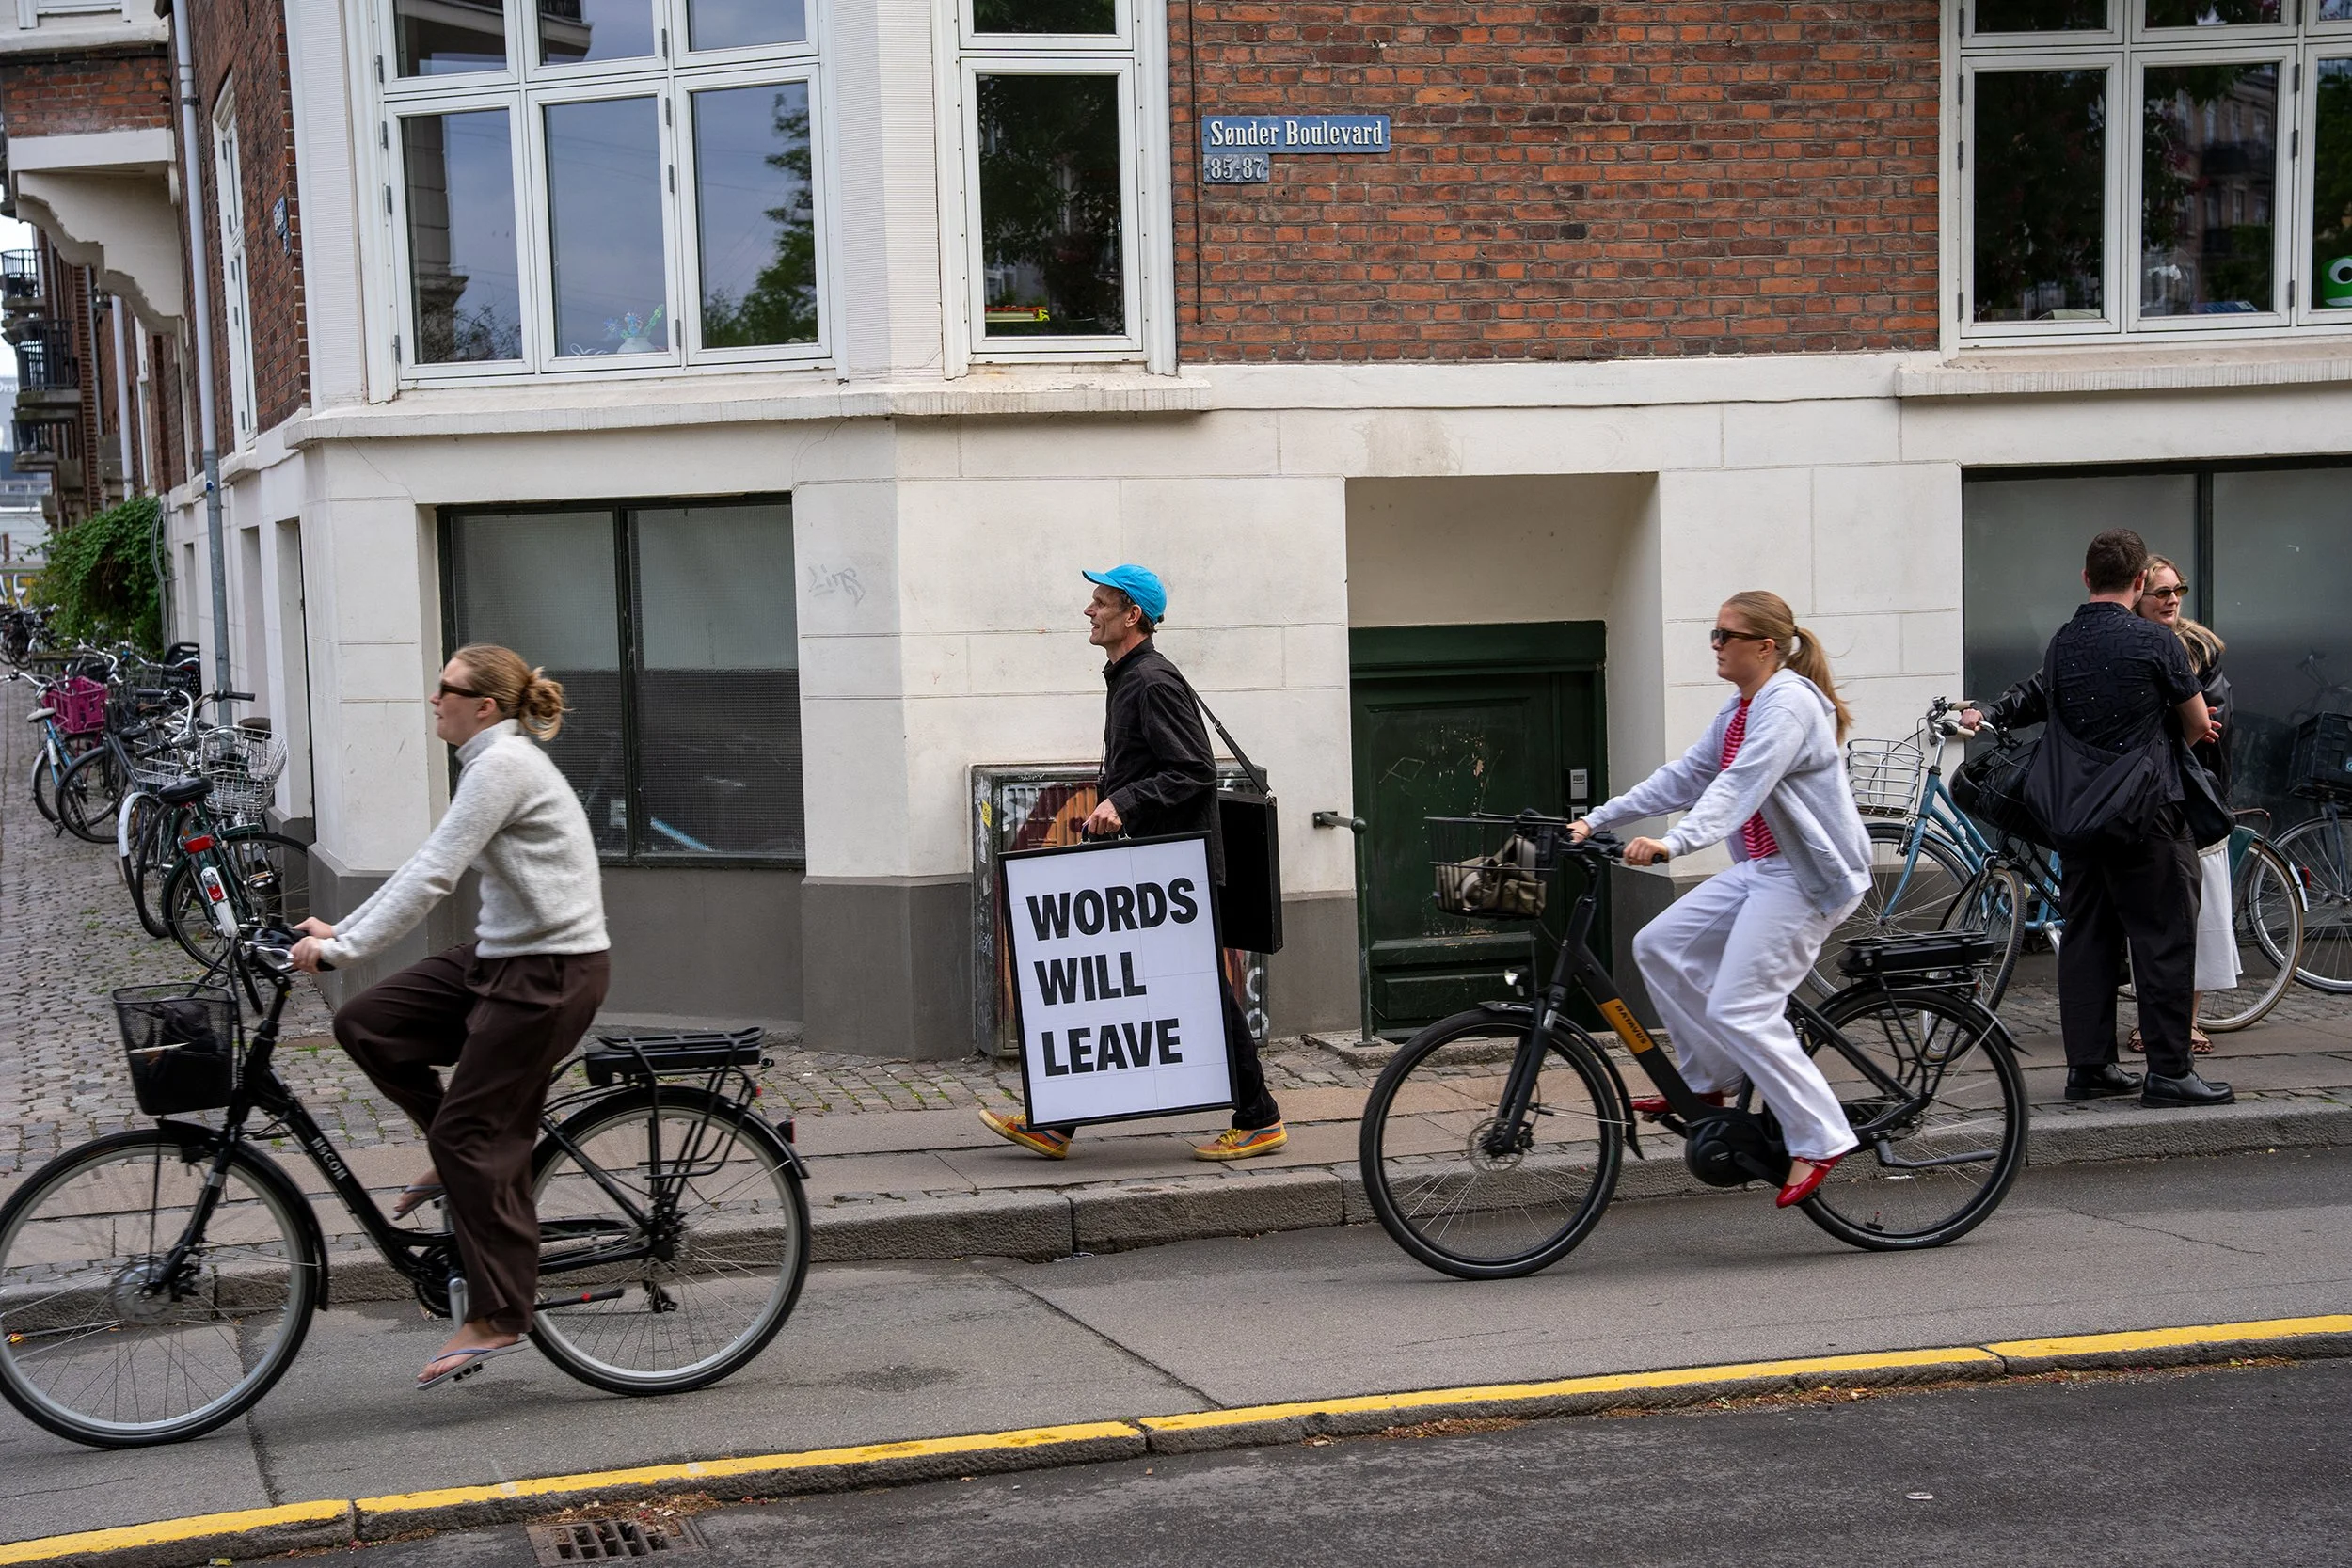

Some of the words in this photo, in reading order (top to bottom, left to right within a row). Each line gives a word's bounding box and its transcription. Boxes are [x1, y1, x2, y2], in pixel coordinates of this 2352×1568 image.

[1210, 120, 1279, 146] Sønder
[1285, 120, 1383, 146] Boulevard
[1210, 157, 1264, 180] 85-87
[1025, 877, 1198, 942] WORDS
[1033, 951, 1147, 1006] WILL
[1041, 1018, 1183, 1077] LEAVE
